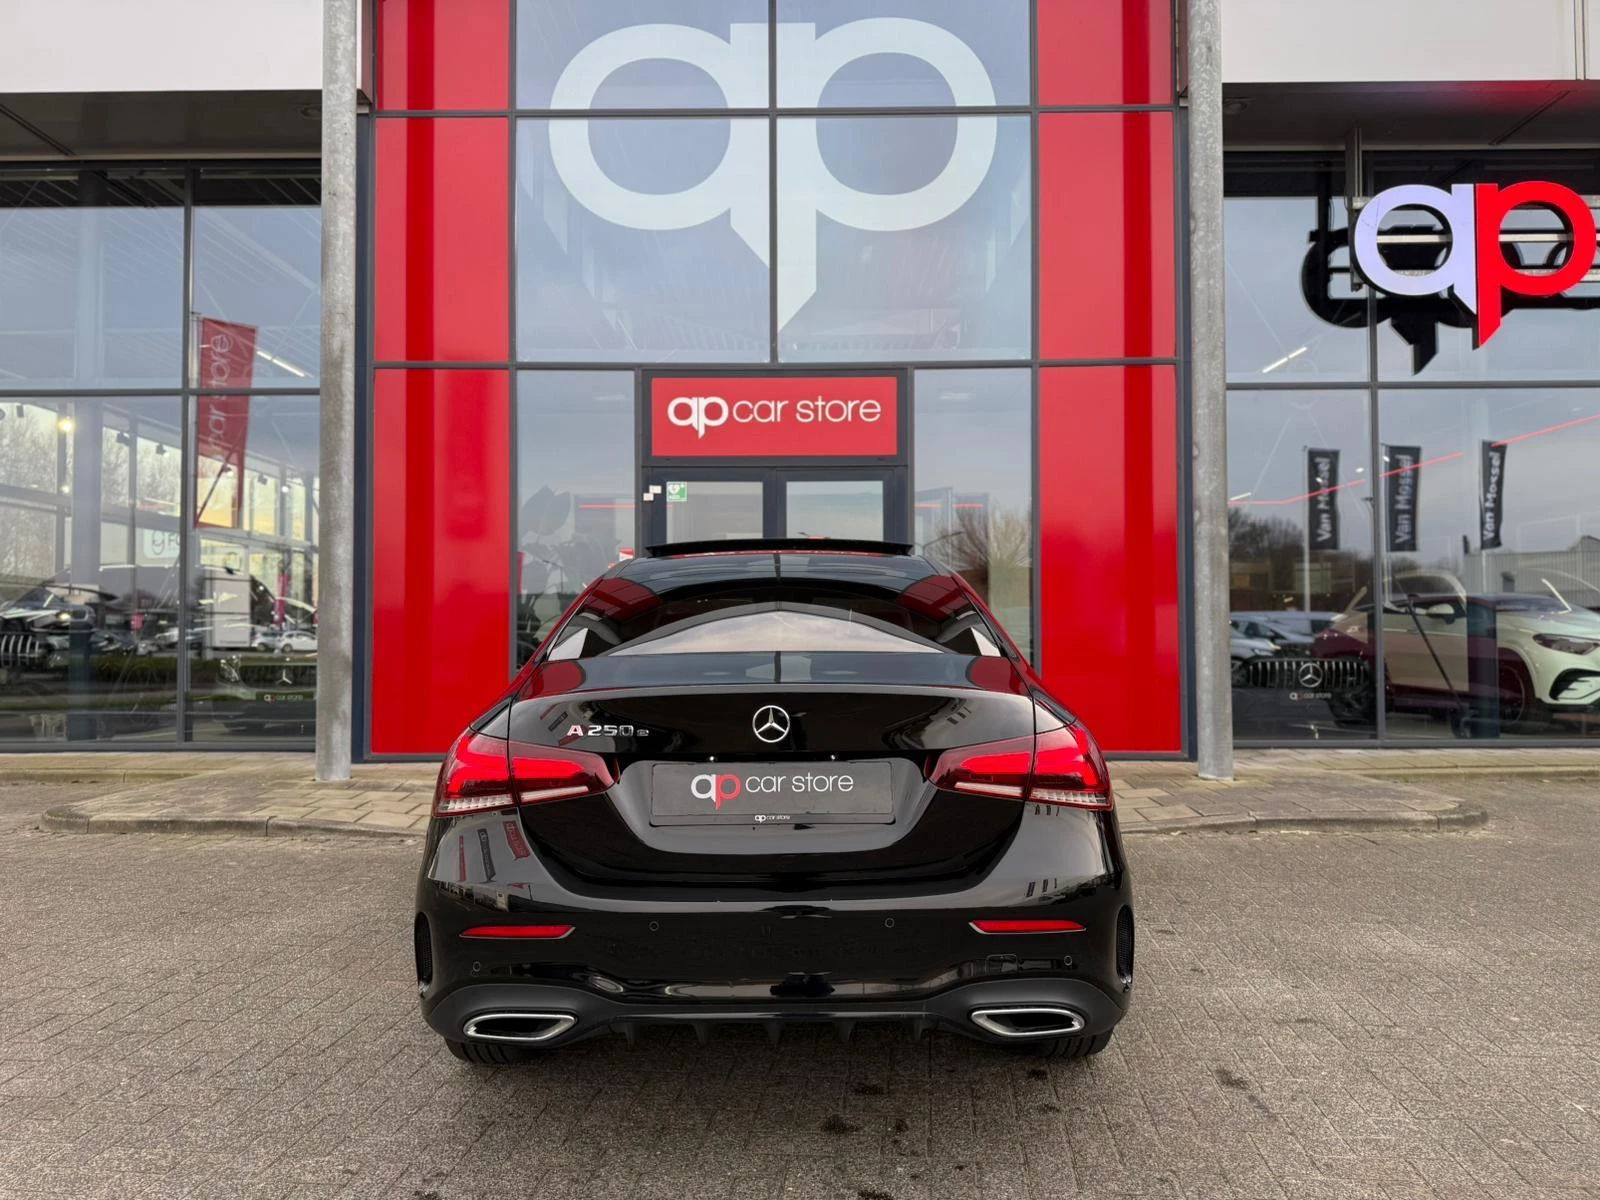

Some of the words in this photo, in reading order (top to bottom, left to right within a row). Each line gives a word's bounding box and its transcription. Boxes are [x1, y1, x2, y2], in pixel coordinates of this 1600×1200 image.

[549, 17, 998, 333] ap
[1354, 181, 1597, 350] ap
[667, 396, 729, 440] ap
[733, 400, 788, 423] car
[796, 395, 882, 423] store
[1395, 454, 1413, 509] Mossel
[1485, 451, 1501, 507] Mossel
[1316, 515, 1332, 541] Van
[1395, 515, 1412, 544] Van
[1483, 513, 1495, 540] Van
[690, 773, 742, 811] ap
[745, 773, 786, 793] car
[792, 772, 854, 793] store
